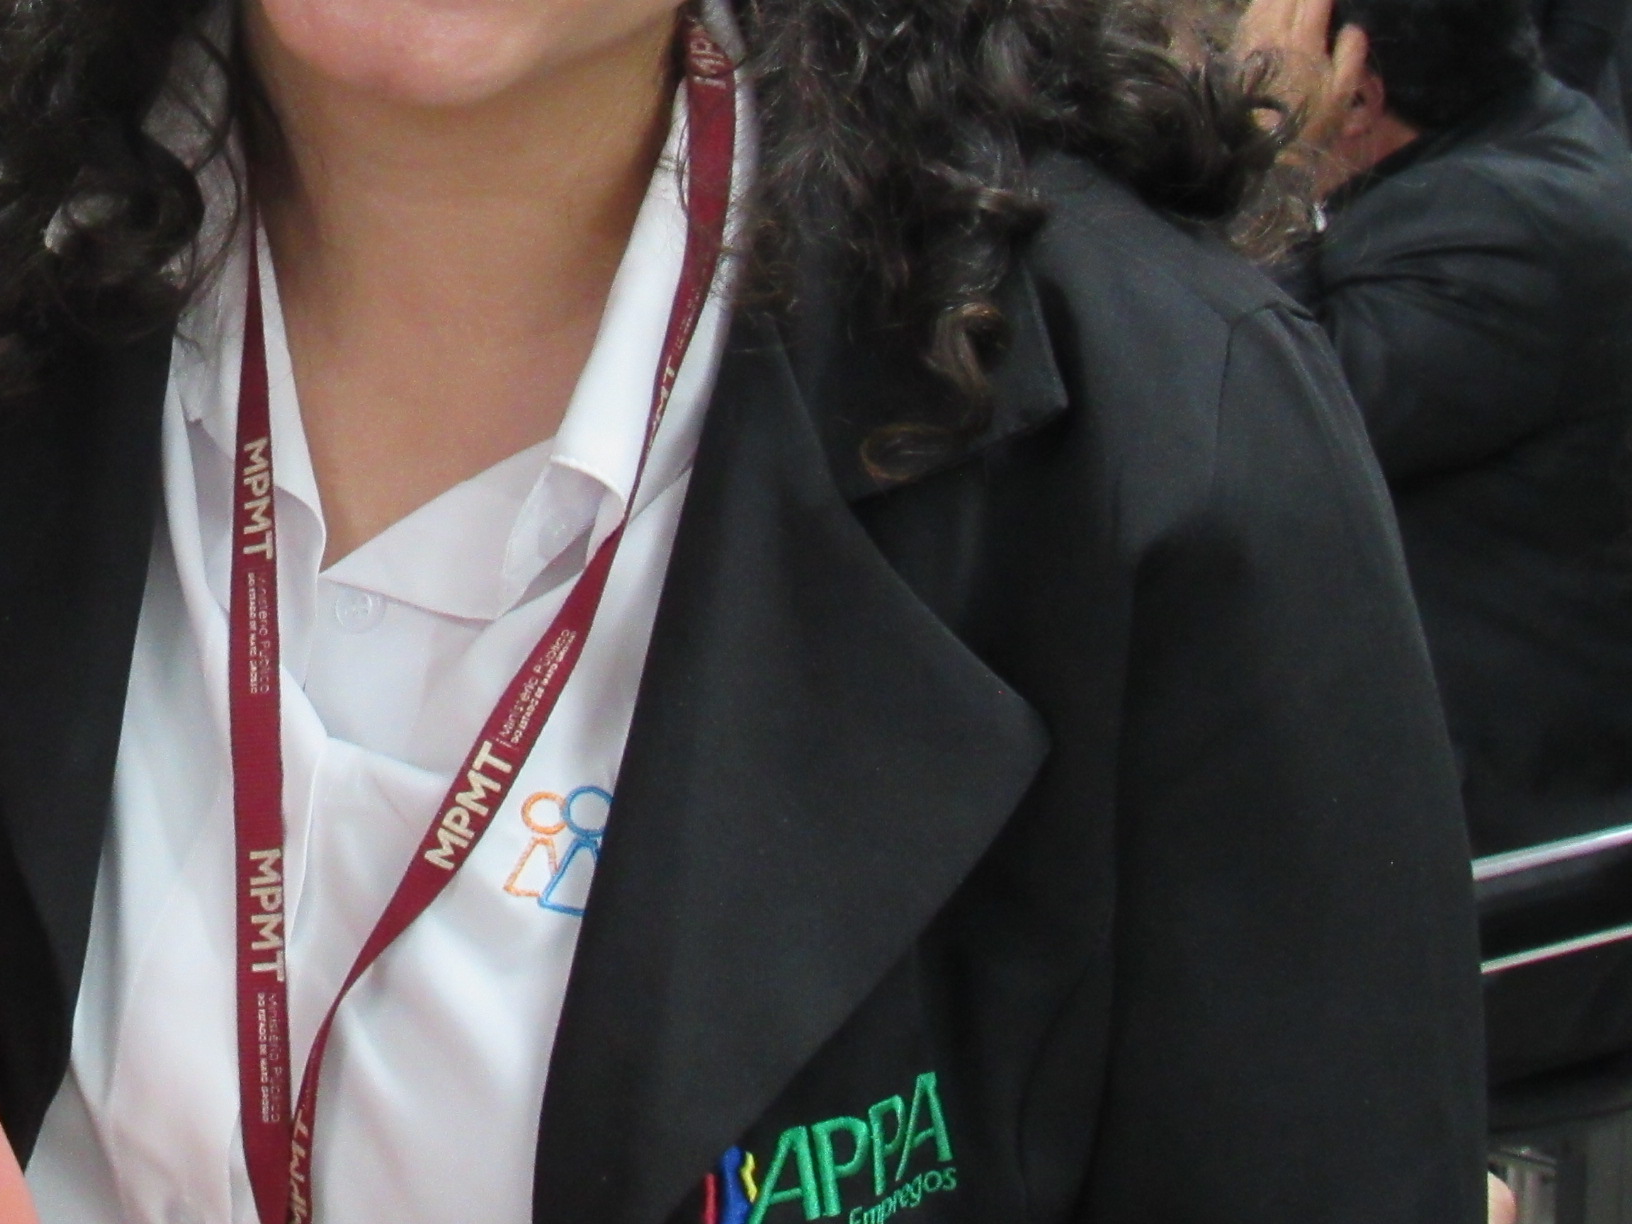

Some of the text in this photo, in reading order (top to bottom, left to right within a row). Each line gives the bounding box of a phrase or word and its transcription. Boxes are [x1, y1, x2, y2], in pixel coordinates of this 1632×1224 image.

[242, 436, 274, 560] MPMT
[424, 740, 513, 870] MPMT
[249, 848, 285, 981] MPMT
[748, 1072, 953, 1224] APPA
